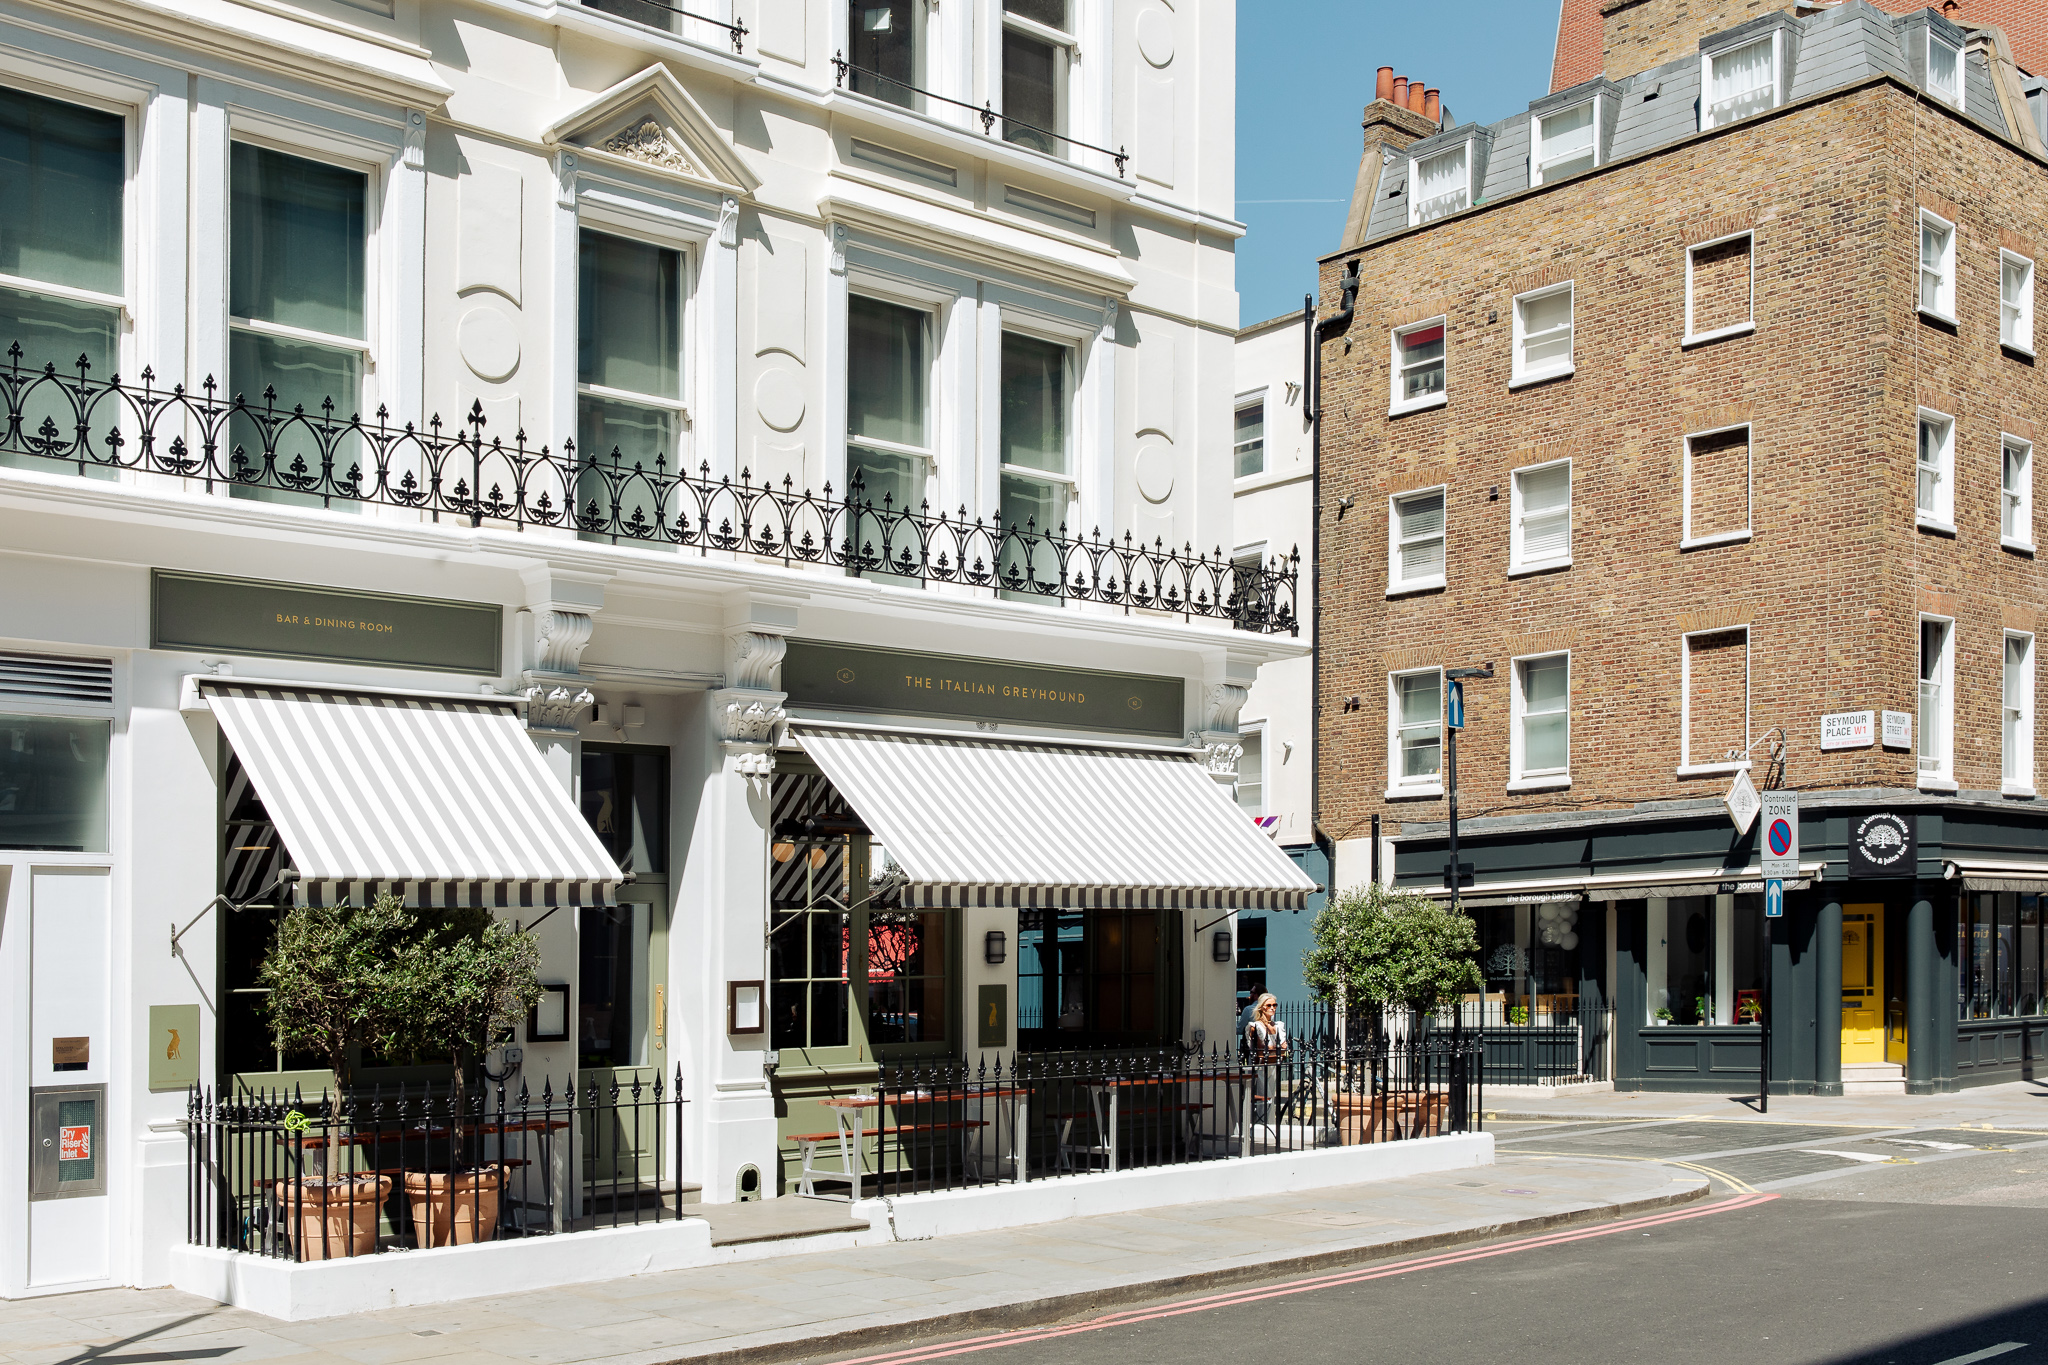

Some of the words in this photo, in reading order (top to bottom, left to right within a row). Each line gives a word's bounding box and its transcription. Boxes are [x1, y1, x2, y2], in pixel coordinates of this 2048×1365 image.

[276, 613, 299, 624] BAR
[303, 616, 311, 625] &
[315, 617, 356, 629] DINING
[360, 621, 393, 633] ROOM
[905, 675, 932, 689] THE
[940, 679, 995, 695] ITALIAN
[1002, 685, 1085, 704] GREYHOUND
[1826, 714, 1867, 727] SEYMOUR
[1886, 714, 1906, 725] SEYMOUR
[1826, 726, 1851, 738] PLACE
[1853, 726, 1867, 735] W1
[1886, 725, 1902, 736] STREET
[1903, 727, 1910, 736] W1
[1763, 794, 1796, 803] Controlled
[1768, 805, 1791, 815] ZONE
[1857, 823, 1867, 834] the
[1863, 812, 1891, 825] borough
[1891, 814, 1909, 834] barista
[1859, 845, 1877, 863] coffee
[1877, 857, 1883, 865] &
[1883, 854, 1900, 866] juice
[1897, 843, 1908, 856] bar
[1721, 882, 1735, 891] the
[1737, 881, 1764, 890] borou
[1507, 894, 1519, 903] the
[1520, 892, 1551, 902] borough
[61, 1128, 76, 1140] Dry
[61, 1138, 82, 1149] Riser
[61, 1148, 78, 1159] Inlet
